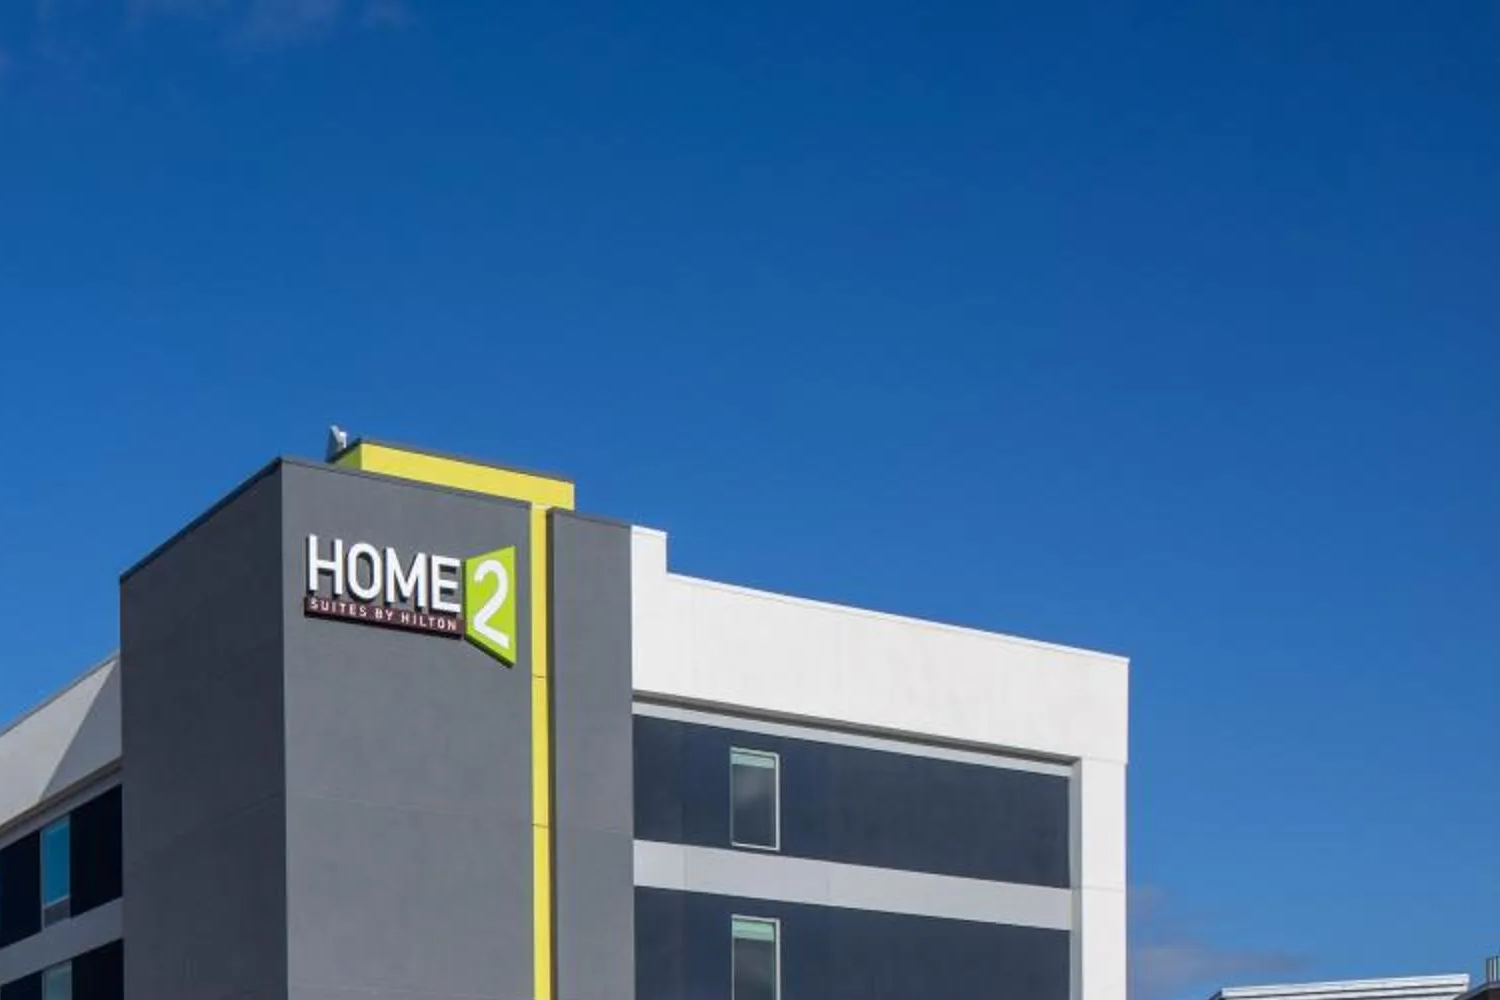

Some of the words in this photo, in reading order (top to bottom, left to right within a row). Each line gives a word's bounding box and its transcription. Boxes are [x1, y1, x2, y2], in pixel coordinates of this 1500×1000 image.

[309, 599, 367, 617] SUITES
[374, 608, 394, 622] BY
[400, 615, 457, 631] HILTON
